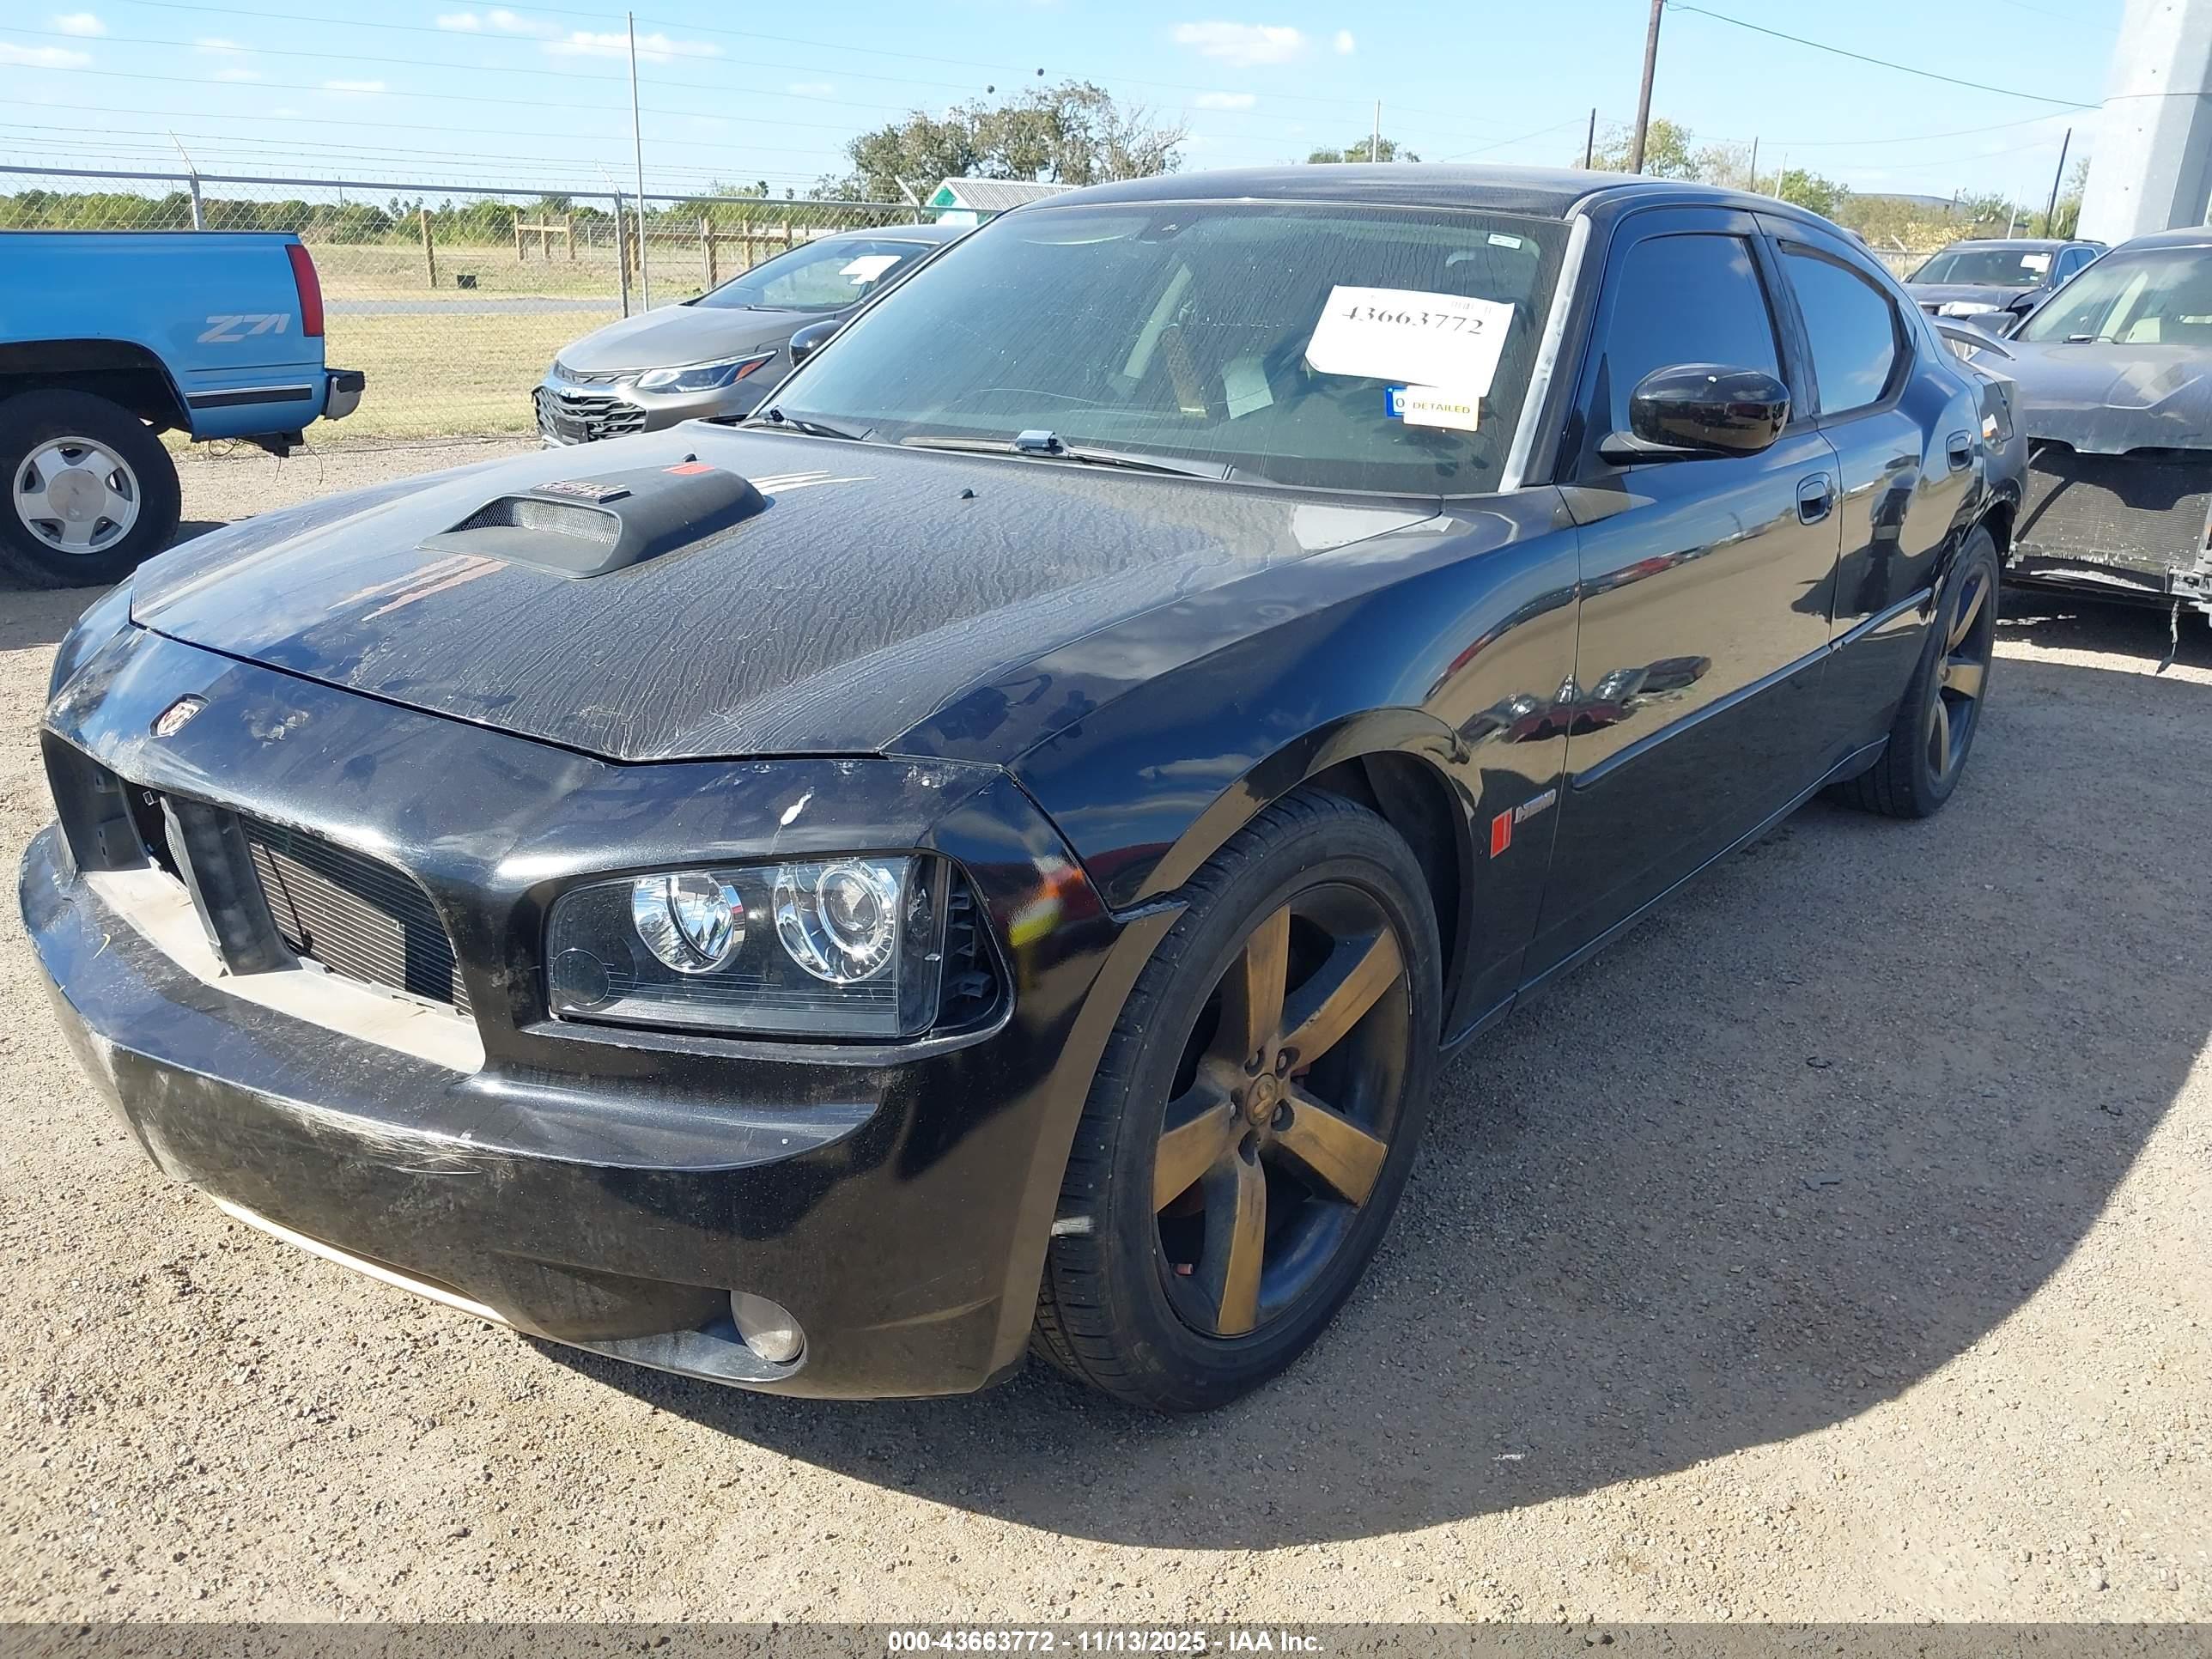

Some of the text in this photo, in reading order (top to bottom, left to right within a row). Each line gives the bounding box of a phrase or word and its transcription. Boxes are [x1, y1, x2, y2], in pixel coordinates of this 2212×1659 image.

[197, 313, 291, 343] Z71
[1342, 306, 1484, 335] 43663772
[1413, 401, 1471, 414] DETAILED
